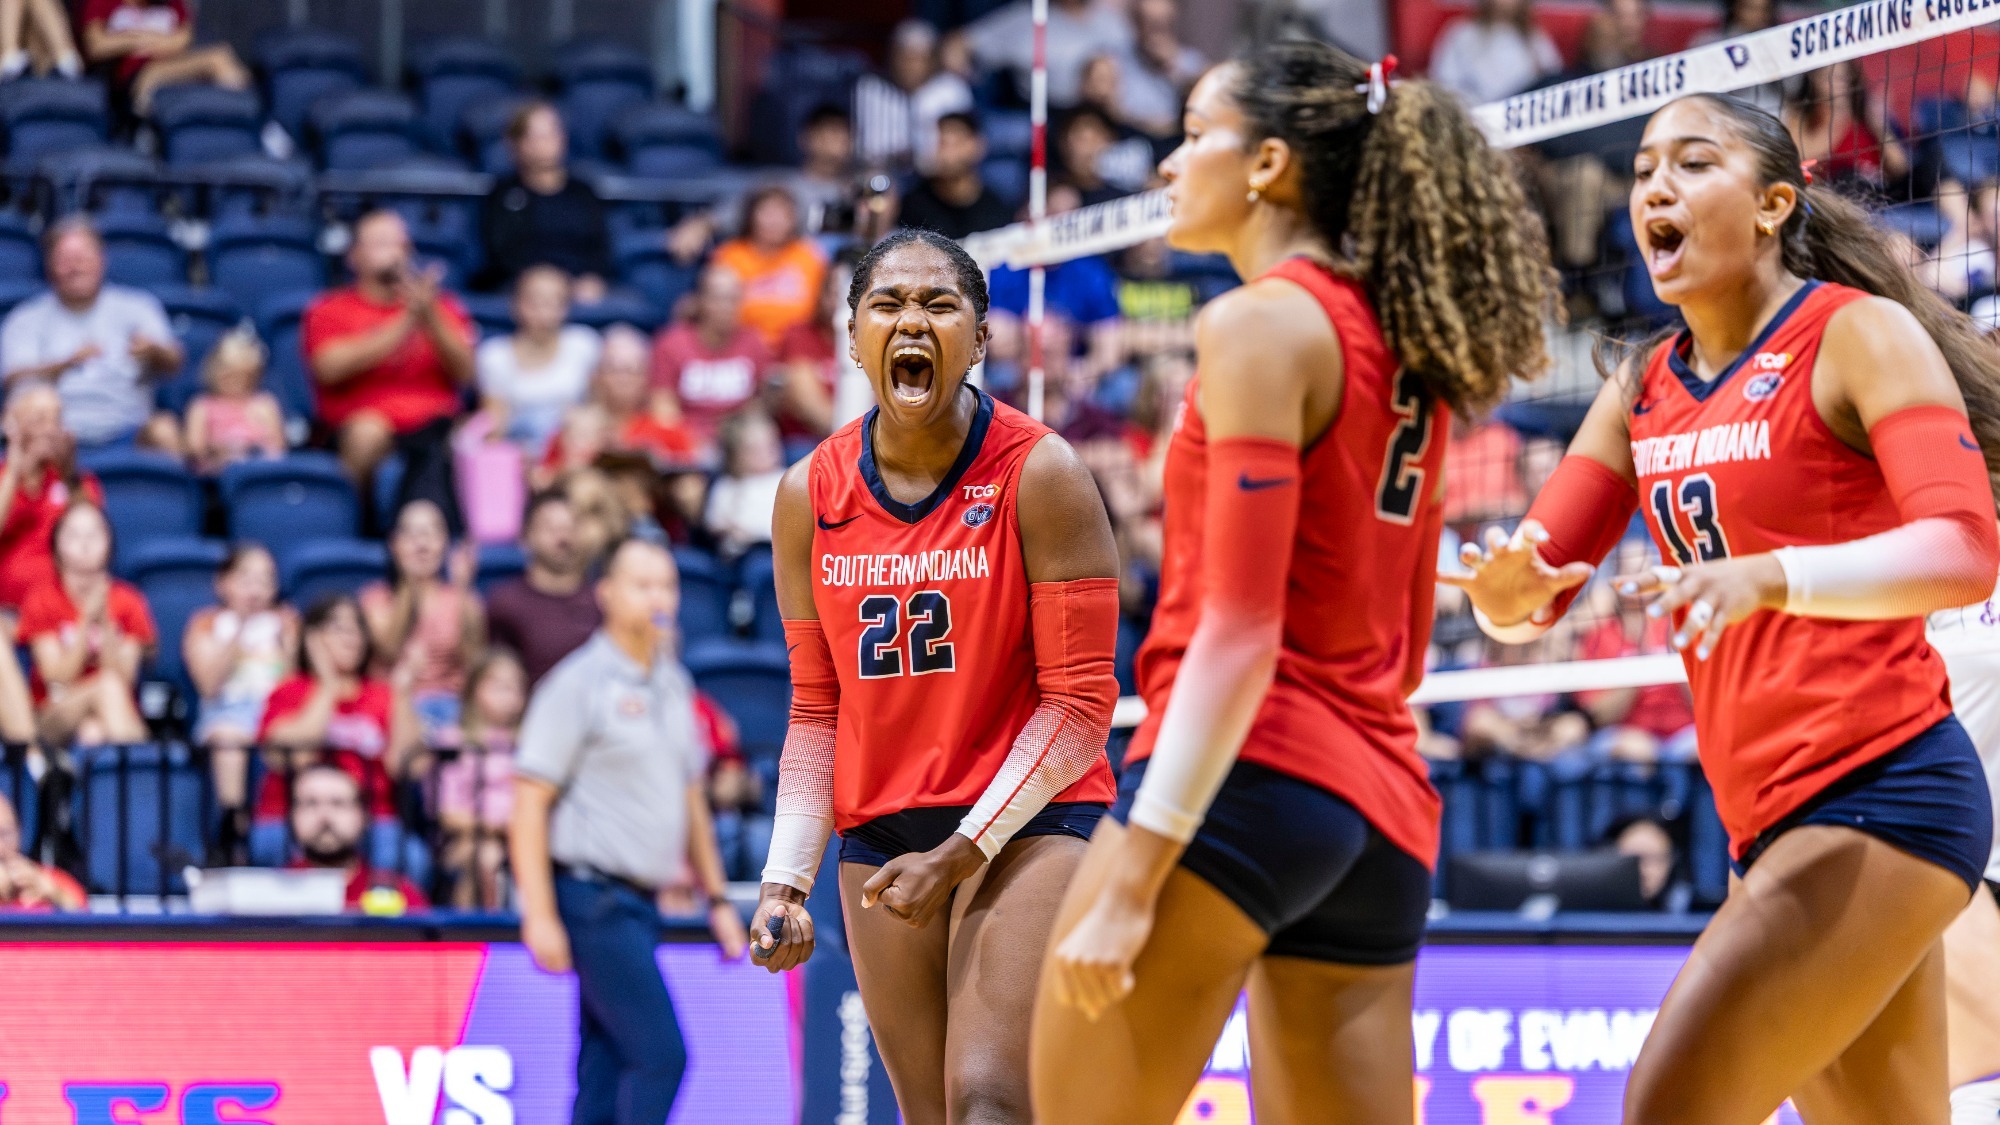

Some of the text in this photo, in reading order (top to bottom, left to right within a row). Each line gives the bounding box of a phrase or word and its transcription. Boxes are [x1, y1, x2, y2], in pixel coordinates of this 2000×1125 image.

[1791, 0, 2000, 58] SCREAMING EAG
[1619, 59, 1688, 105] EAGLES
[1374, 366, 1434, 527] 2
[1693, 419, 1772, 467] INDIANA
[962, 484, 995, 500] TCG
[1649, 471, 1732, 565] 13
[821, 545, 990, 587] SOUTHERN INDIANA
[858, 589, 956, 680] 22
[1448, 1008, 1514, 1072] OF
[1518, 1008, 1661, 1072] EVAN
[369, 1045, 515, 1125] VS
